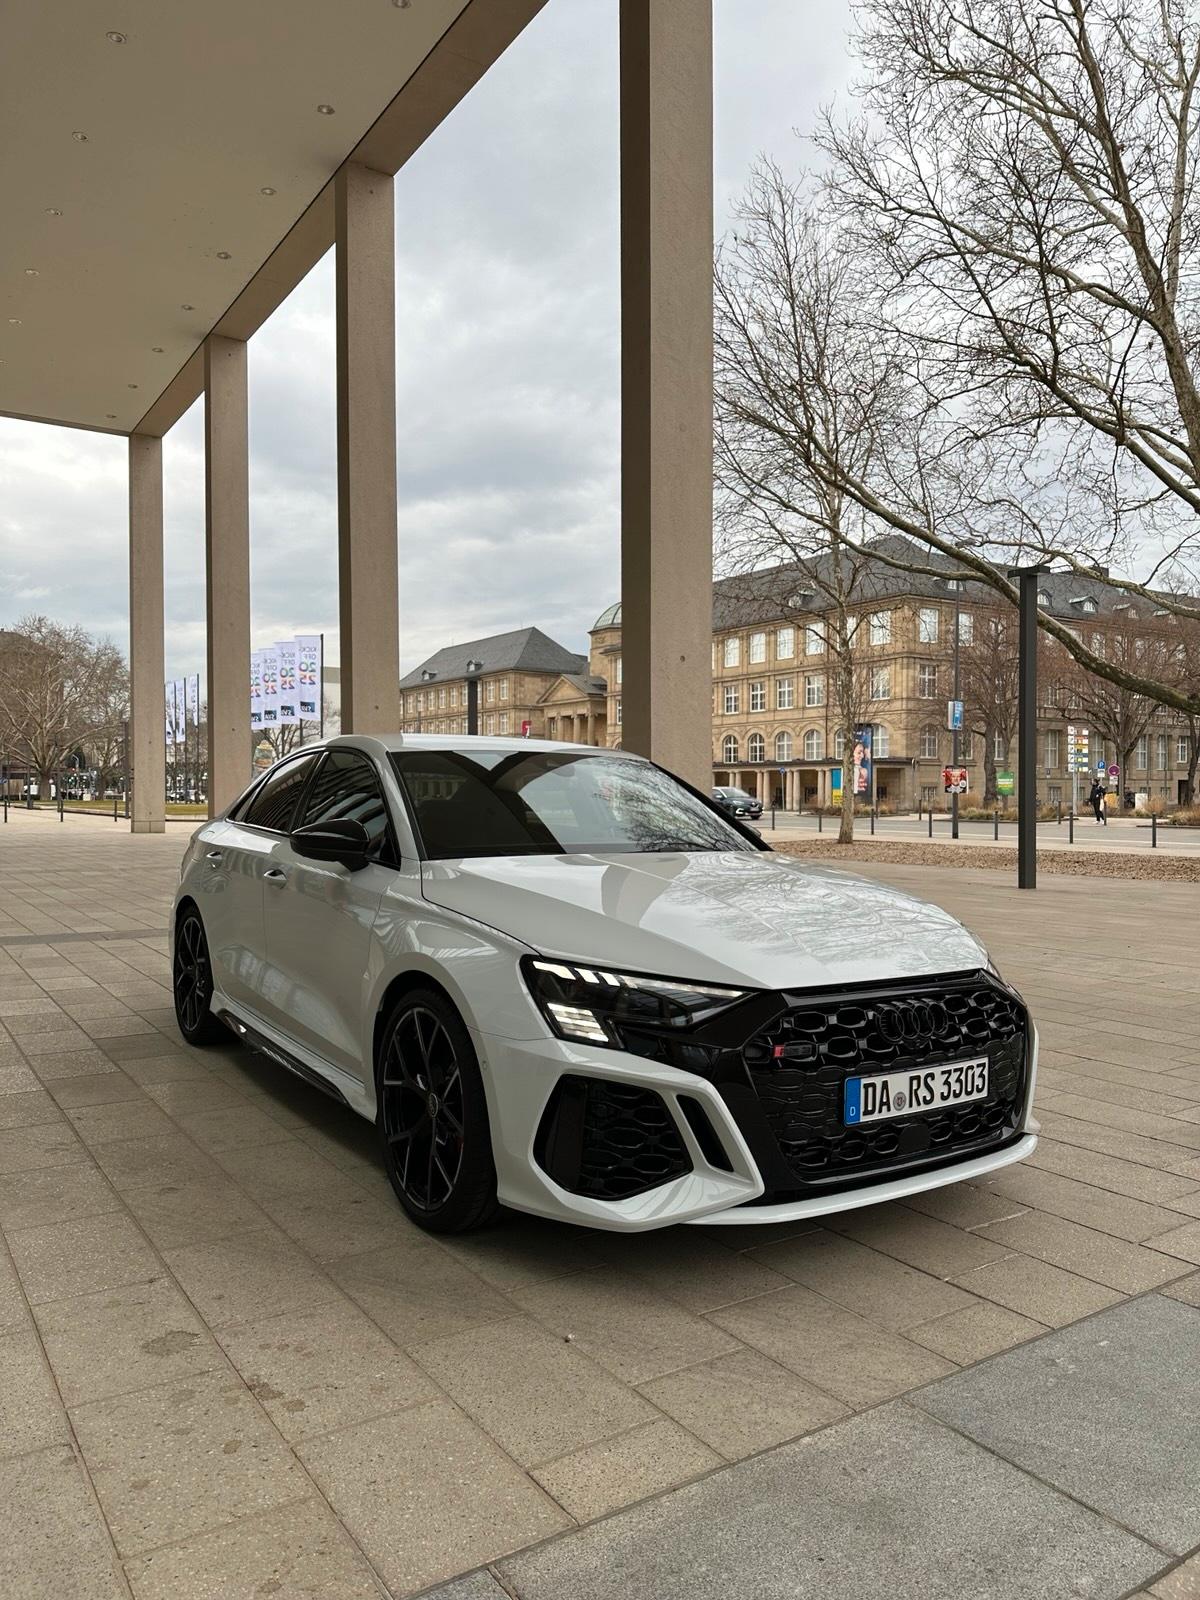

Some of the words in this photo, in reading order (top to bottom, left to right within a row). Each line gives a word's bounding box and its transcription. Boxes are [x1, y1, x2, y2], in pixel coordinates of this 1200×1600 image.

[862, 1079, 891, 1116] DA
[909, 1072, 935, 1108] RS
[940, 1062, 986, 1101] 3303
[849, 1106, 856, 1117] D
